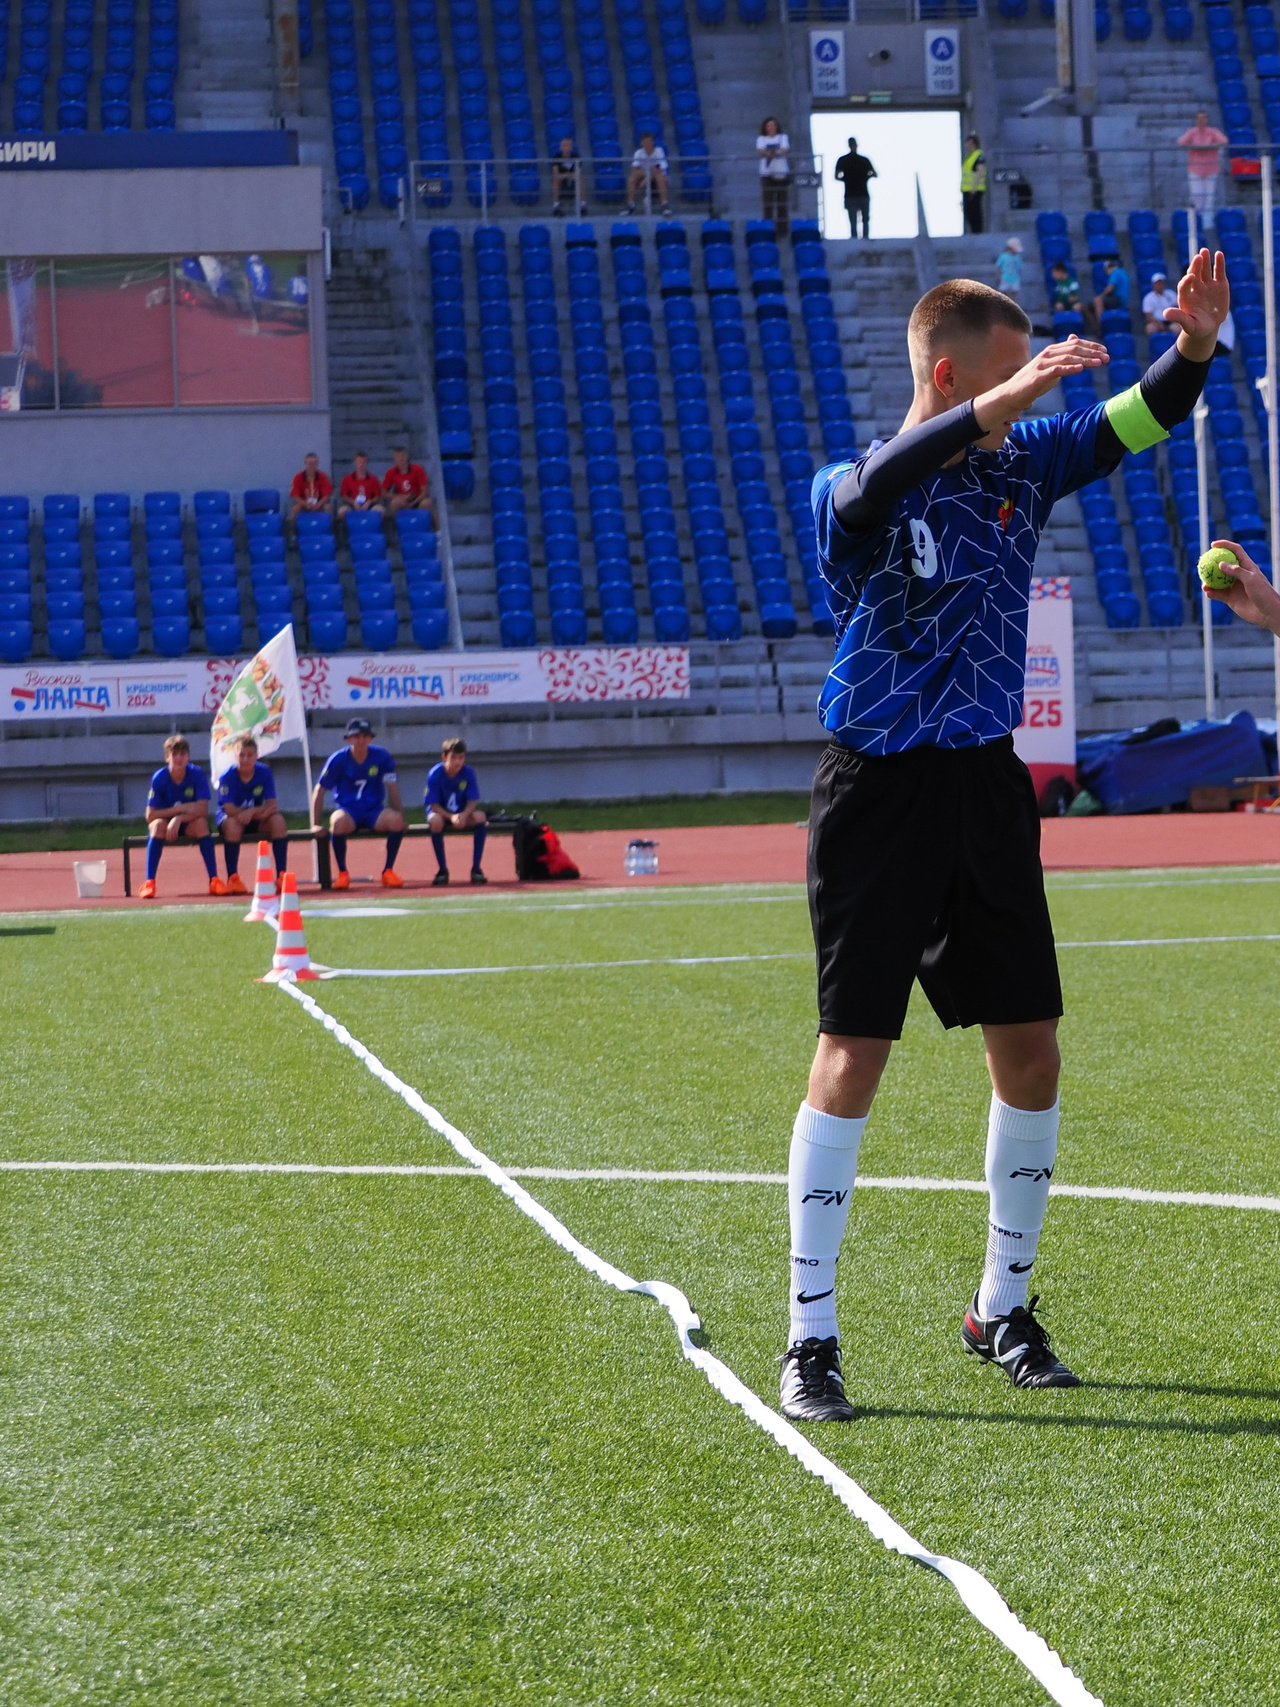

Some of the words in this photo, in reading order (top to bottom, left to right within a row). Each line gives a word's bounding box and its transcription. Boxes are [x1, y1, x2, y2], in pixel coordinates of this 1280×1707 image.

[0, 141, 56, 162] ИРИ
[909, 518, 938, 578] 9
[368, 675, 444, 699] ЛАПТА
[460, 672, 521, 683] КРАСНОЯРСК
[126, 682, 188, 694] КРАСНОЯРСК
[461, 684, 489, 696] 2025
[33, 686, 111, 711] ЛАПТА
[127, 694, 156, 707] 2025
[354, 779, 367, 800] 7
[447, 792, 459, 812] 4
[801, 1189, 848, 1206] FN
